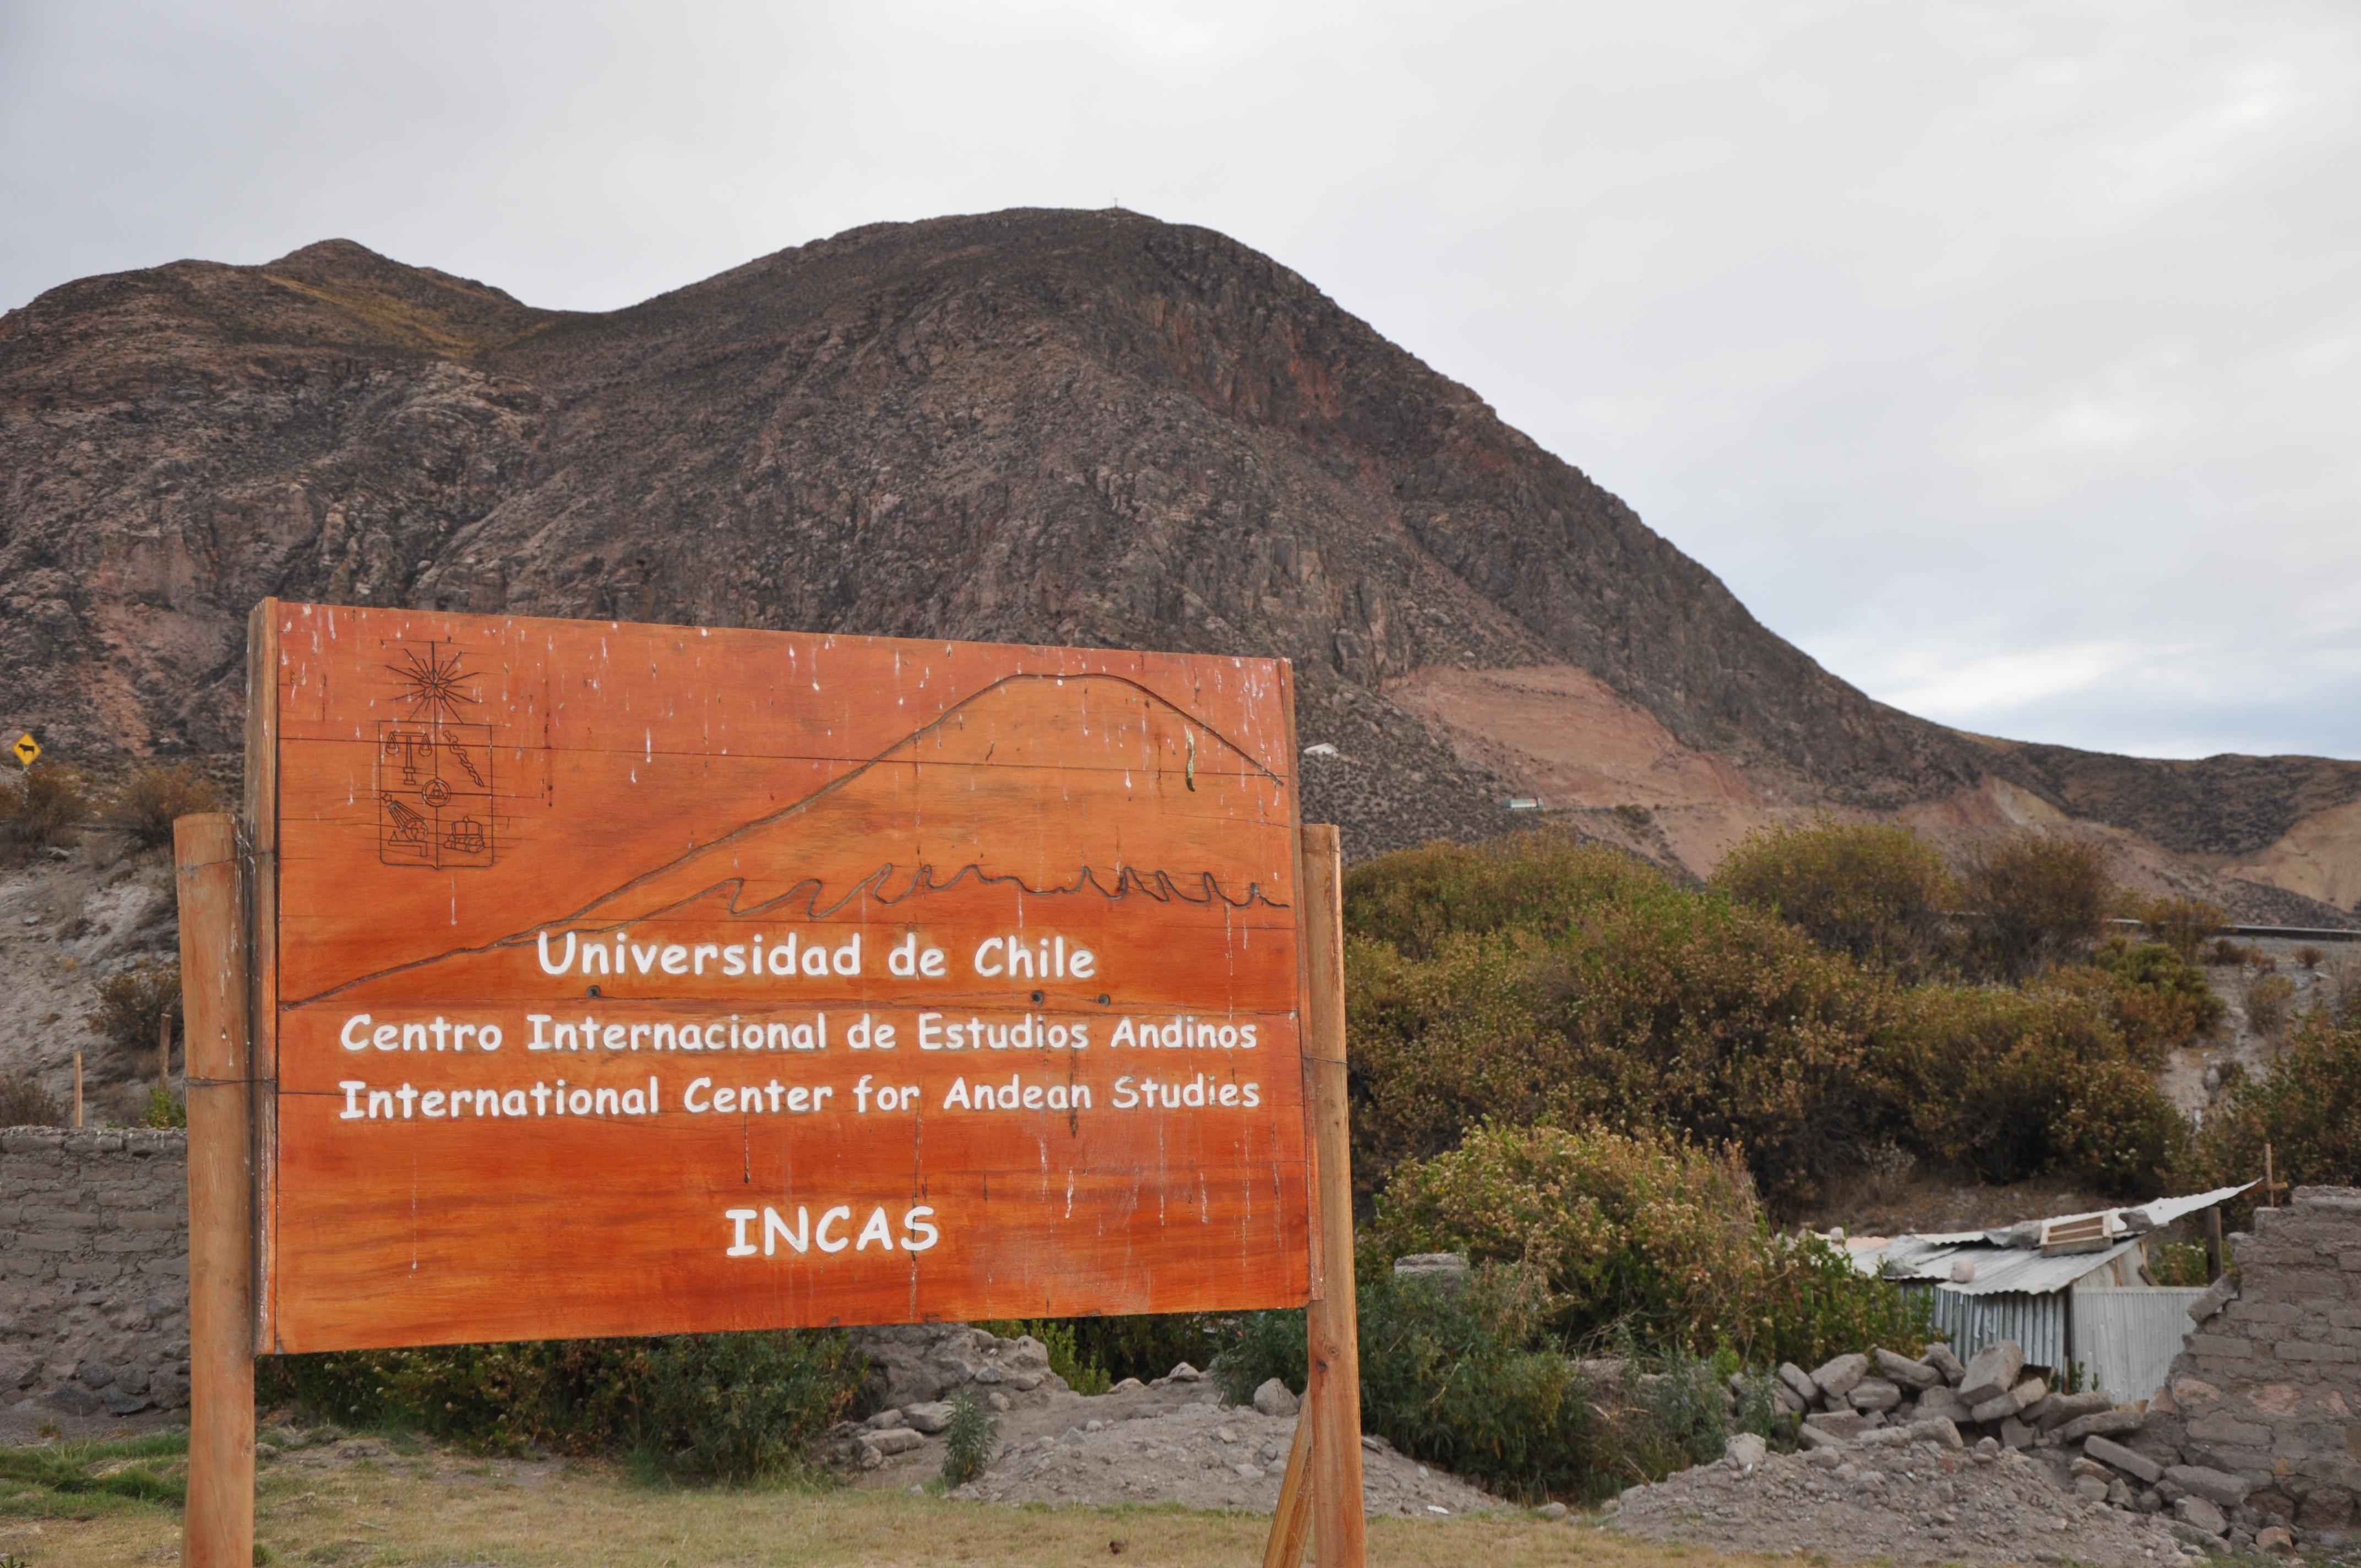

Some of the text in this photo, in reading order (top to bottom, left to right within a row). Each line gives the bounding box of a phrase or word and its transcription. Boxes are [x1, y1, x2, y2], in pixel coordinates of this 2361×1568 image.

[536, 930, 1096, 979] Universidad de Chile
[340, 1011, 1258, 1053] Centro Internacional de Estudios Andinos
[338, 1072, 1260, 1120] International Center for Andean Studies
[725, 1205, 939, 1257] INCAS
